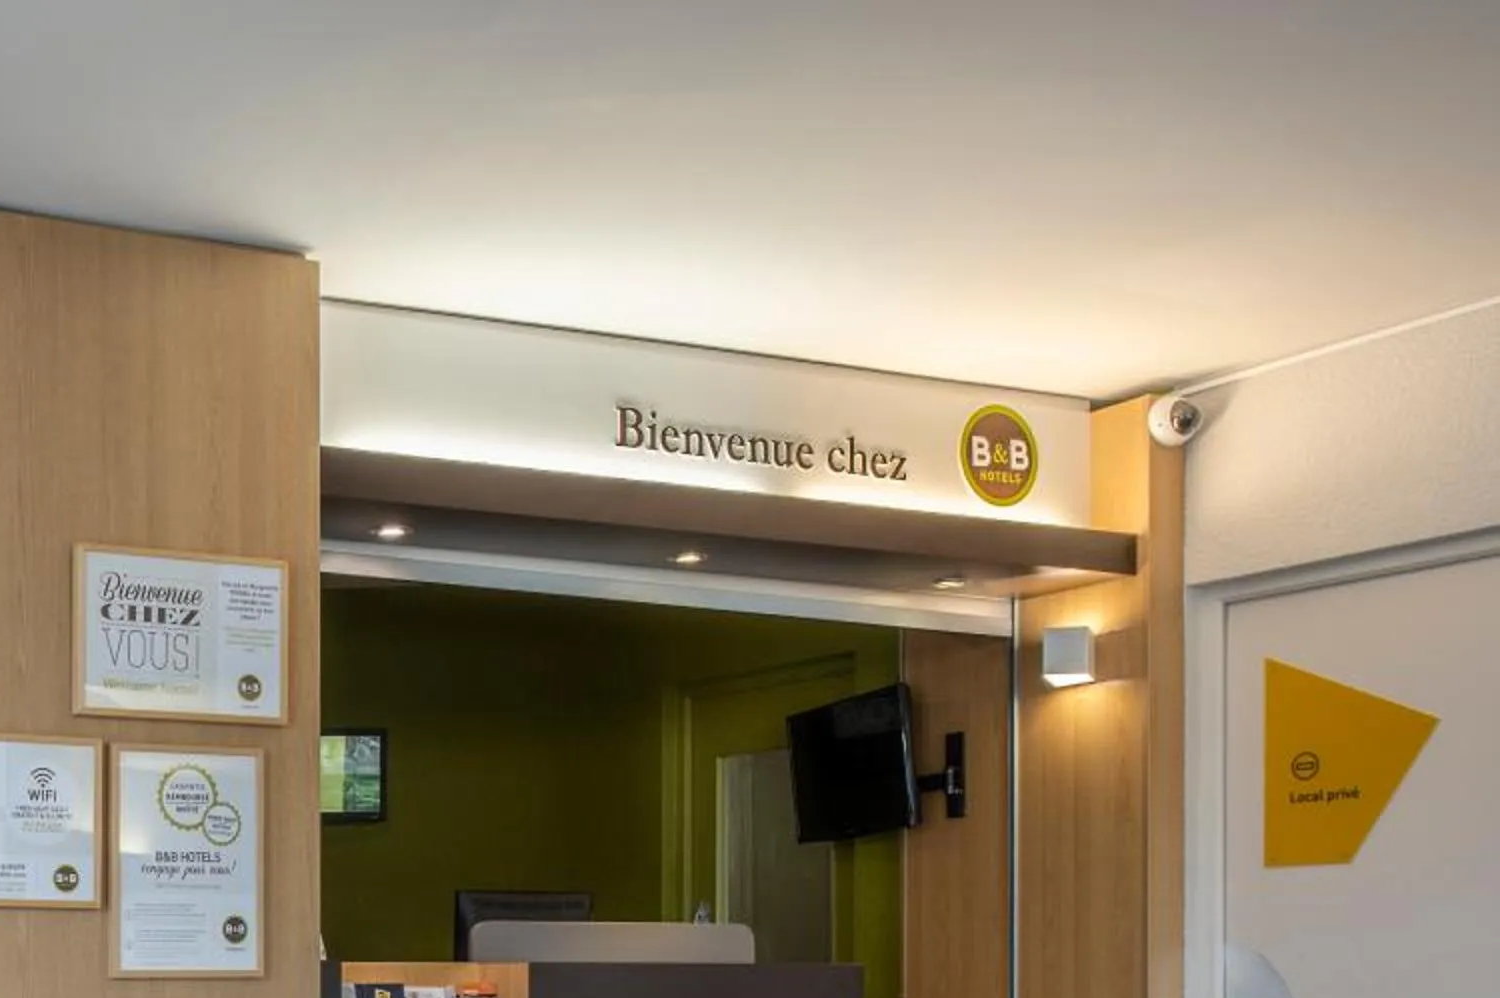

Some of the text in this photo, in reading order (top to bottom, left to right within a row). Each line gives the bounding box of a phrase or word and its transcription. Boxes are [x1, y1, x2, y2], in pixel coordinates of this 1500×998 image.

[614, 404, 908, 481] Bienvenue chez
[971, 435, 1029, 471] B&B
[979, 471, 1022, 485] HOTELS
[99, 571, 204, 606] Bienvenue
[100, 603, 201, 626] CHEZ
[1289, 785, 1361, 806] Local privé
[181, 851, 221, 863] HOTELS
